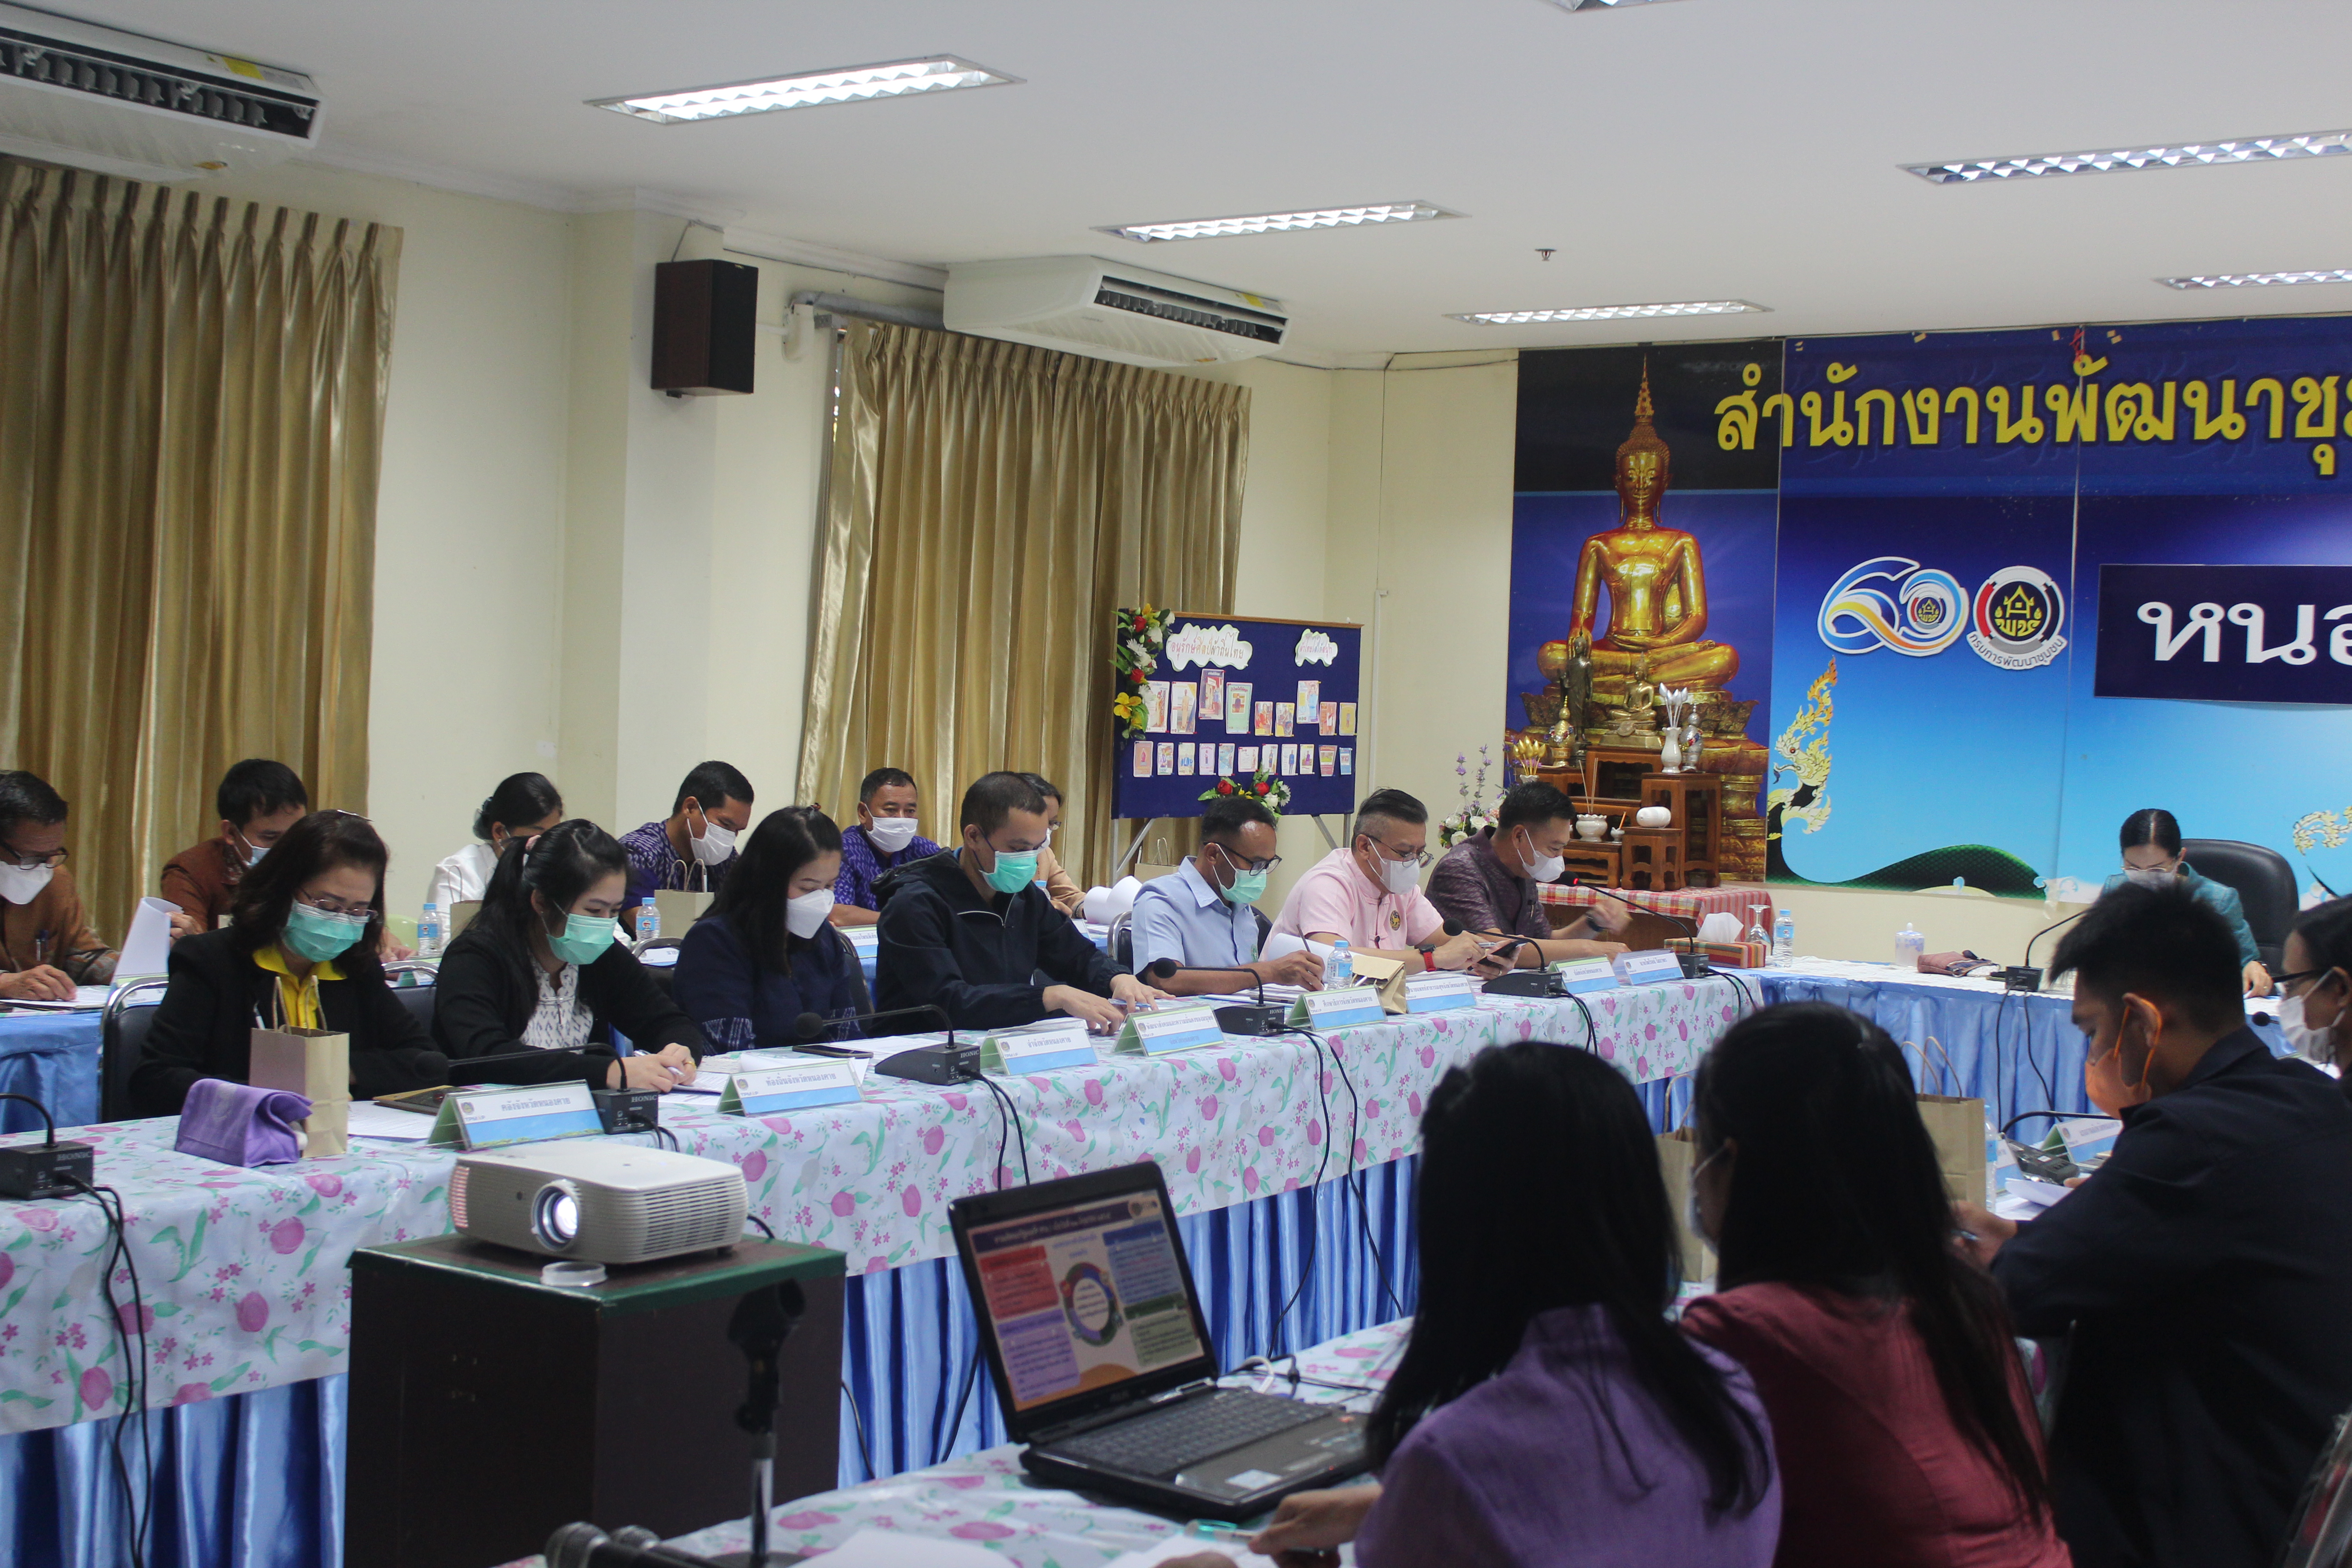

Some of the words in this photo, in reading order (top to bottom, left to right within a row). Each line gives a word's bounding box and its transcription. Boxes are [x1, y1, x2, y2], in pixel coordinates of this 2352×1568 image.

[1714, 354, 2352, 475] สำนักงานพัฒนาชุ
[1969, 633, 2064, 668] กรมการพัฒนาชุมชน
